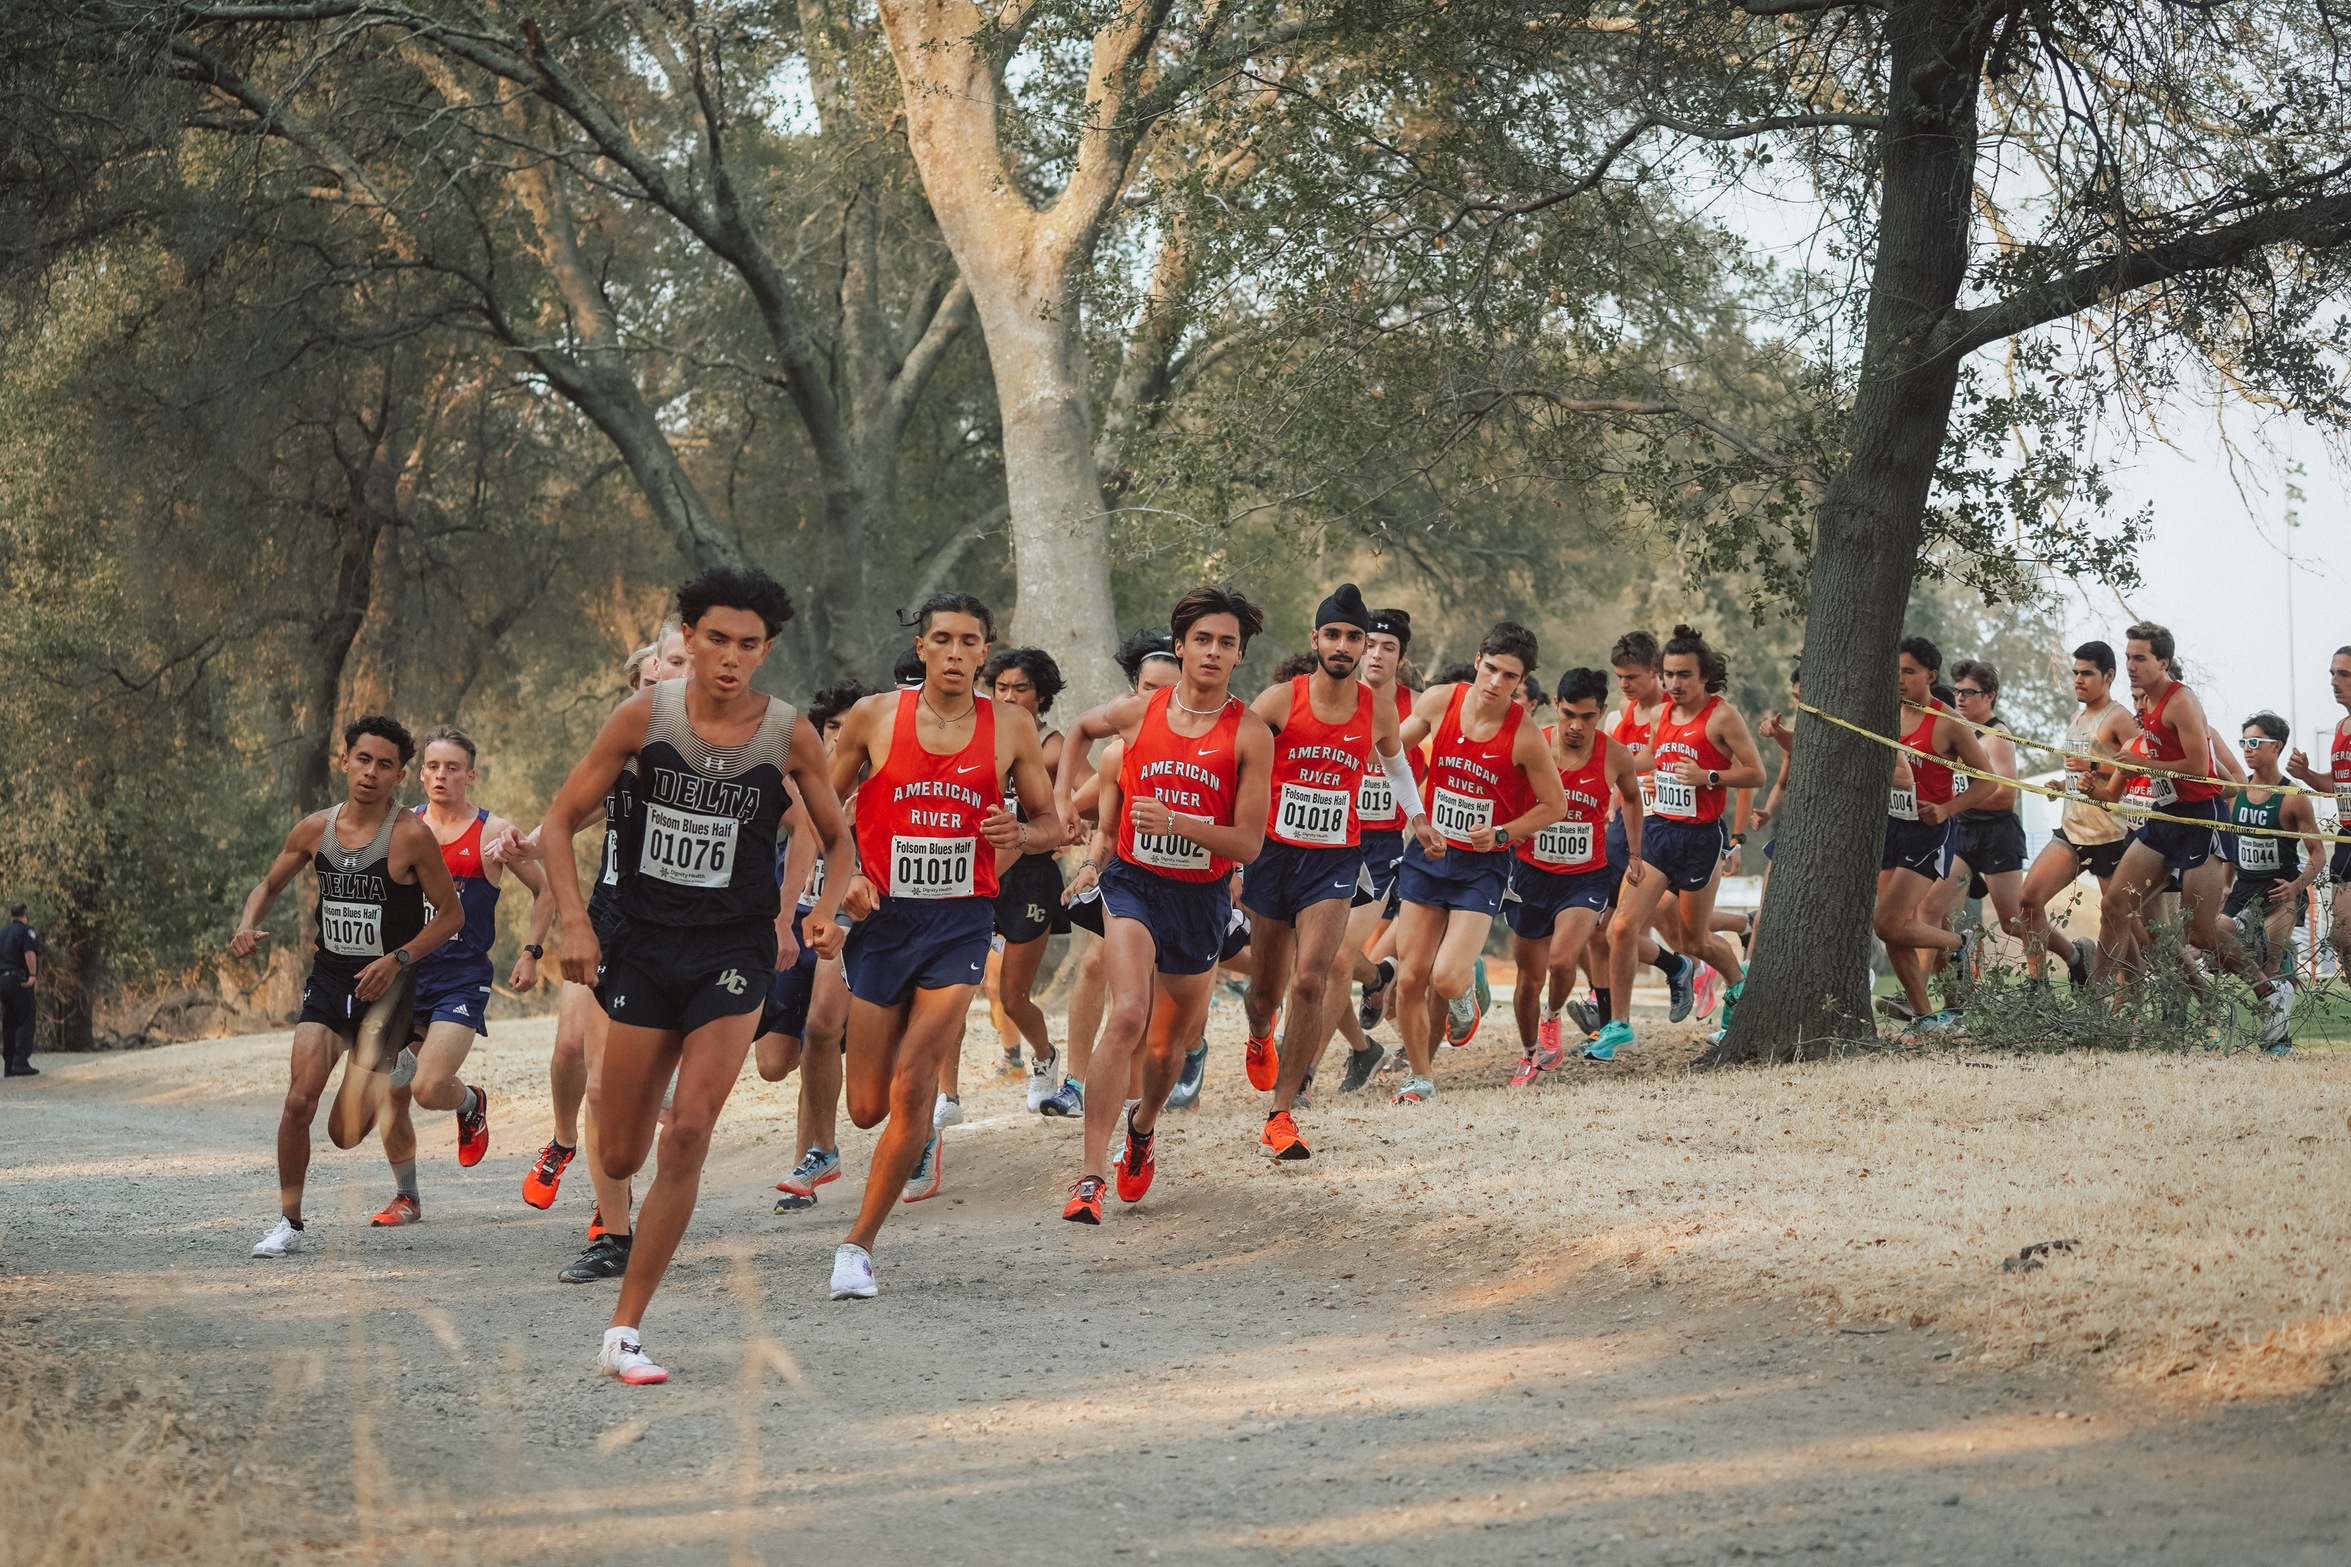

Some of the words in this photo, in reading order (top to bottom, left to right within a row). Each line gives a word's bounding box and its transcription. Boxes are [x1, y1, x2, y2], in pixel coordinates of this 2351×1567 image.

[1288, 746, 1360, 771] AMERICAN
[1654, 742, 1699, 761] AMERICAN
[1140, 760, 1220, 791] AMERICAN
[1299, 768, 1341, 786] RIVER
[1437, 756, 1499, 785] AMERICAN
[652, 767, 761, 821] DELTA
[1363, 779, 1381, 789] Blues
[1447, 775, 1484, 794] RIVER
[893, 781, 982, 809] AMERICAN
[1154, 787, 1200, 807] RIVER
[1285, 788, 1310, 803] Folsom
[1312, 793, 1332, 806] Blues
[1333, 795, 1348, 806] Half
[1355, 790, 1392, 811] 019
[1437, 791, 1457, 806] Folsom
[1458, 798, 1475, 810] Blues
[1476, 802, 1490, 812] Half
[1564, 789, 1598, 808] RICAN
[1658, 785, 1691, 807] 01016
[1889, 793, 1913, 812] 004
[651, 809, 680, 831] Folsom
[682, 819, 709, 836] Blues
[711, 822, 732, 838] Half
[910, 808, 962, 829] RIVER
[1284, 802, 1343, 832] 01018
[2238, 806, 2268, 826] DVC
[1559, 825, 1576, 834] Blues
[1577, 826, 1590, 835] Half
[650, 828, 727, 872] 01076
[896, 841, 927, 854] Folsom
[929, 842, 953, 855] Blues
[955, 841, 971, 854] Half
[1539, 833, 1587, 855] 01009
[2241, 847, 2275, 864] 01044
[670, 869, 688, 878] Dignity
[898, 856, 967, 885] 01010
[317, 870, 387, 901] DELTA
[343, 906, 362, 920] Blues
[363, 908, 378, 920] Half
[1025, 903, 1046, 923] DC
[325, 917, 376, 946] 01070
